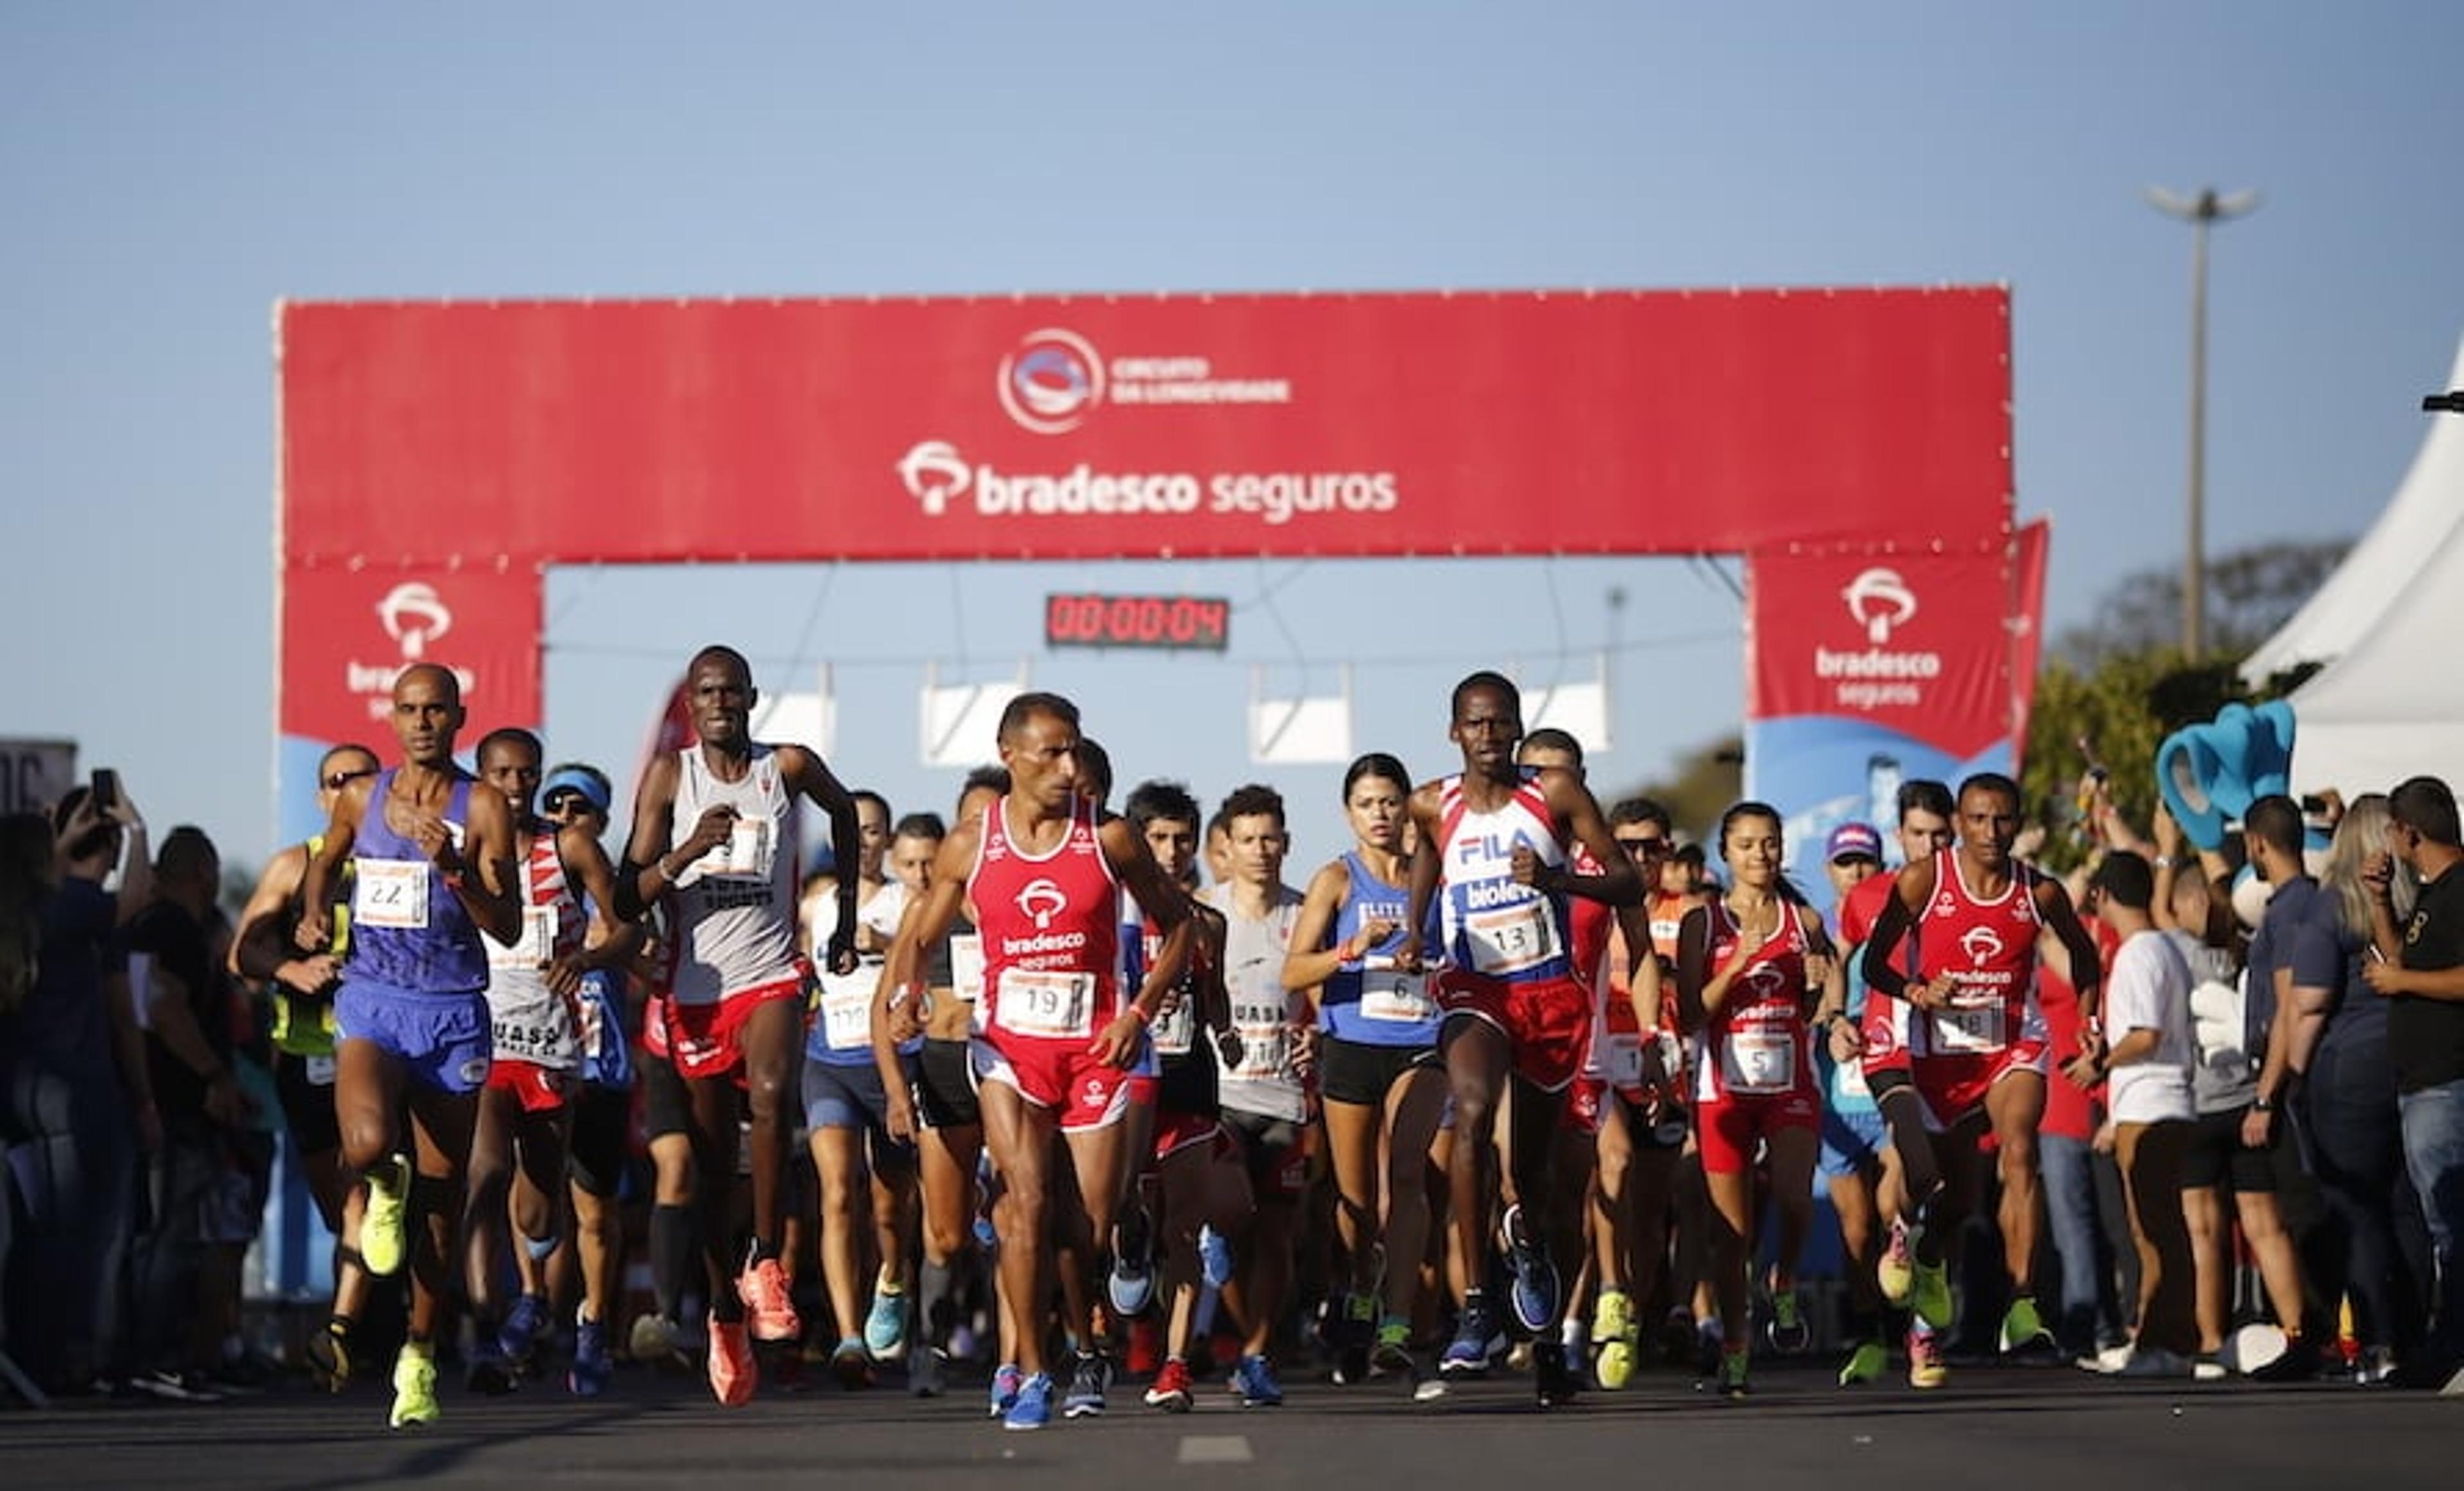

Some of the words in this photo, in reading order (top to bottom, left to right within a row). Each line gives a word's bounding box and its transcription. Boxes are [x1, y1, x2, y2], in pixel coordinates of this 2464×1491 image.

[976, 463, 1200, 514] bradesco
[1210, 472, 1398, 524] seguros
[1815, 645, 1942, 677] bradesco
[1837, 681, 1921, 711] seguros
[370, 880, 402, 904] 22
[1002, 932, 1086, 956] bradesco
[1494, 927, 1526, 951] 13
[1018, 953, 1075, 971] seguros
[1394, 977, 1408, 1000] 6
[1026, 988, 1059, 1015] 19
[1752, 1050, 1768, 1073] 5
